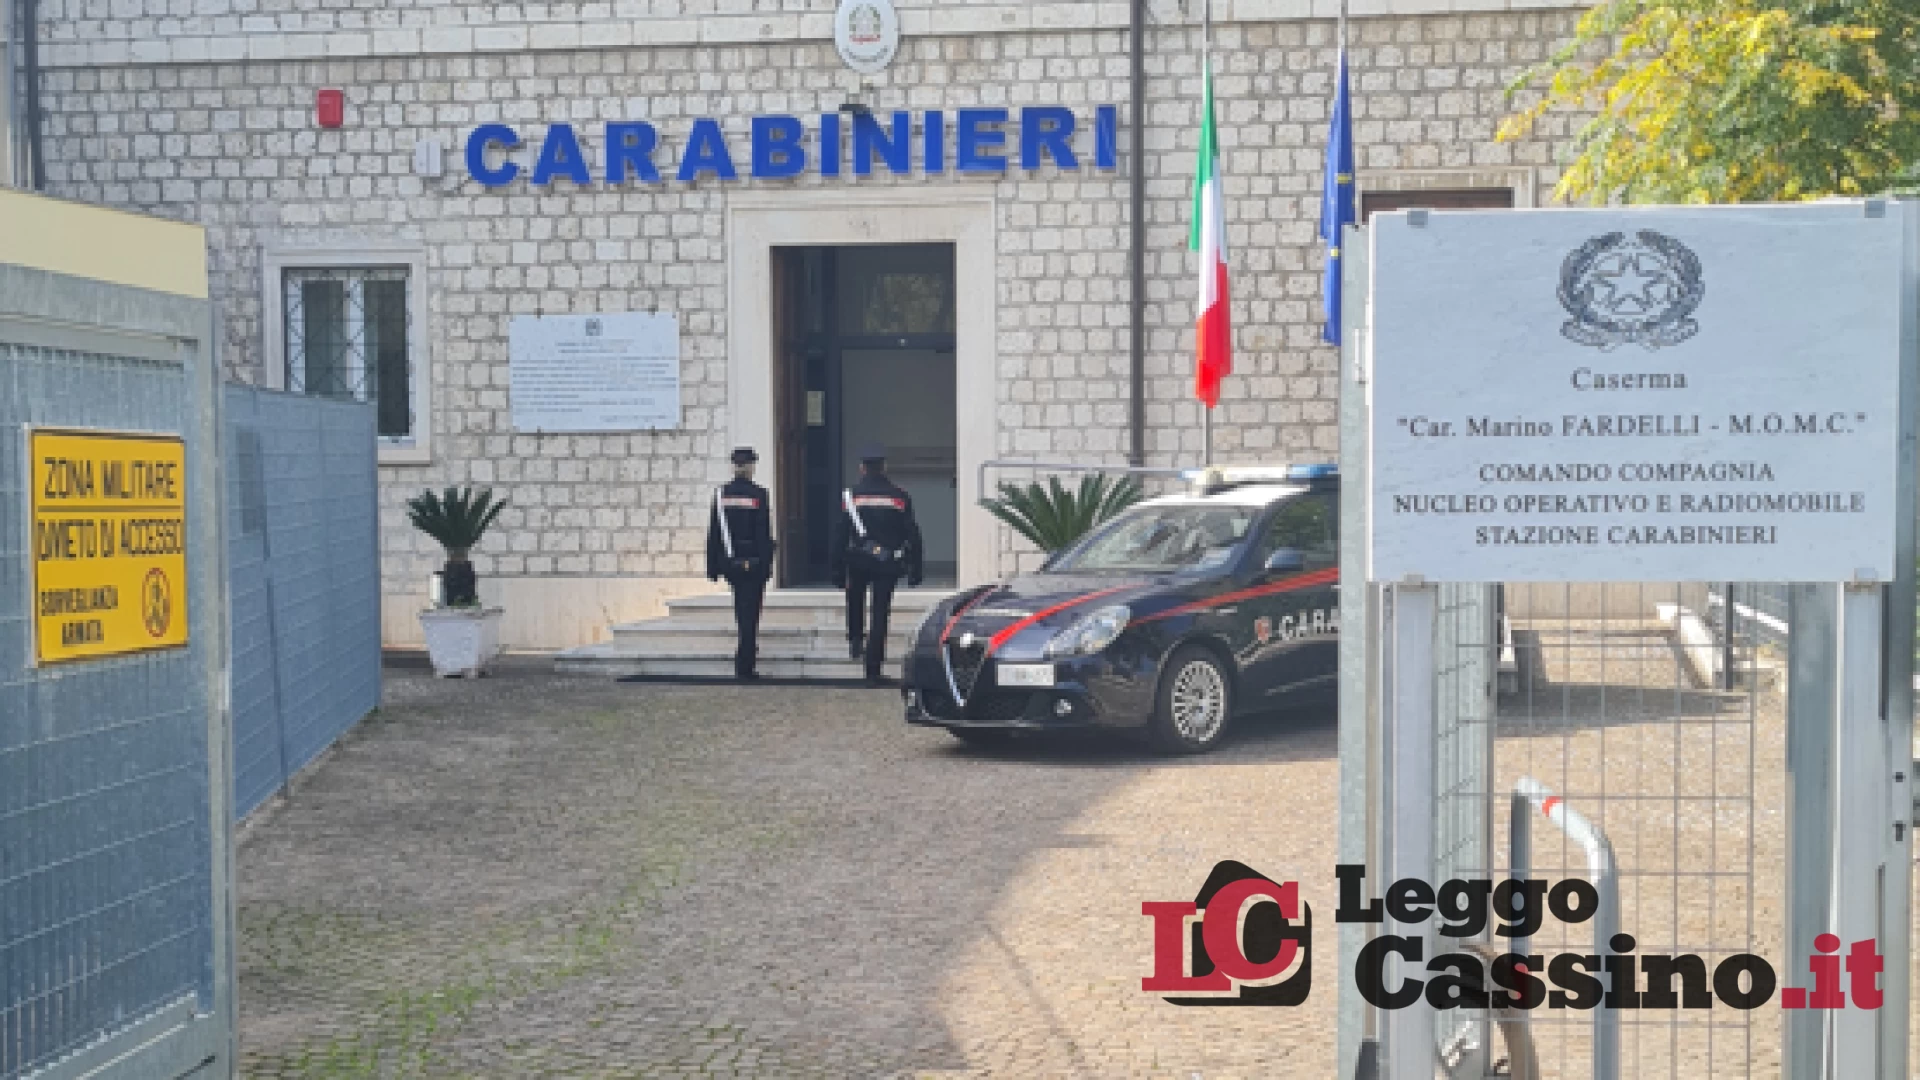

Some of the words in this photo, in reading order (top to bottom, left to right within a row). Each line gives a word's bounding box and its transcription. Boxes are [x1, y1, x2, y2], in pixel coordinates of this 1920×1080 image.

[466, 103, 1116, 187] CARABINIERI
[1571, 368, 1687, 390] Caserma
[1397, 417, 1457, 438] "Car.
[1466, 415, 1553, 438] Marino
[1562, 415, 1700, 437] FARDELLI
[1729, 411, 1866, 434] M.O.M.C."
[44, 457, 96, 499] ZONA
[103, 460, 177, 499] MILITARE
[1479, 461, 1611, 482] COMANDO
[1618, 461, 1775, 482] COMPAGNIA
[1393, 492, 1496, 513] NUCLEO
[1503, 492, 1648, 513] OPERATIVO
[1656, 495, 1672, 514] E
[1679, 492, 1865, 513] RADIOMOBILE
[119, 518, 182, 555] ACCESSO
[1475, 525, 1599, 545] STAZIONE
[1607, 525, 1778, 545] CARABINIERI
